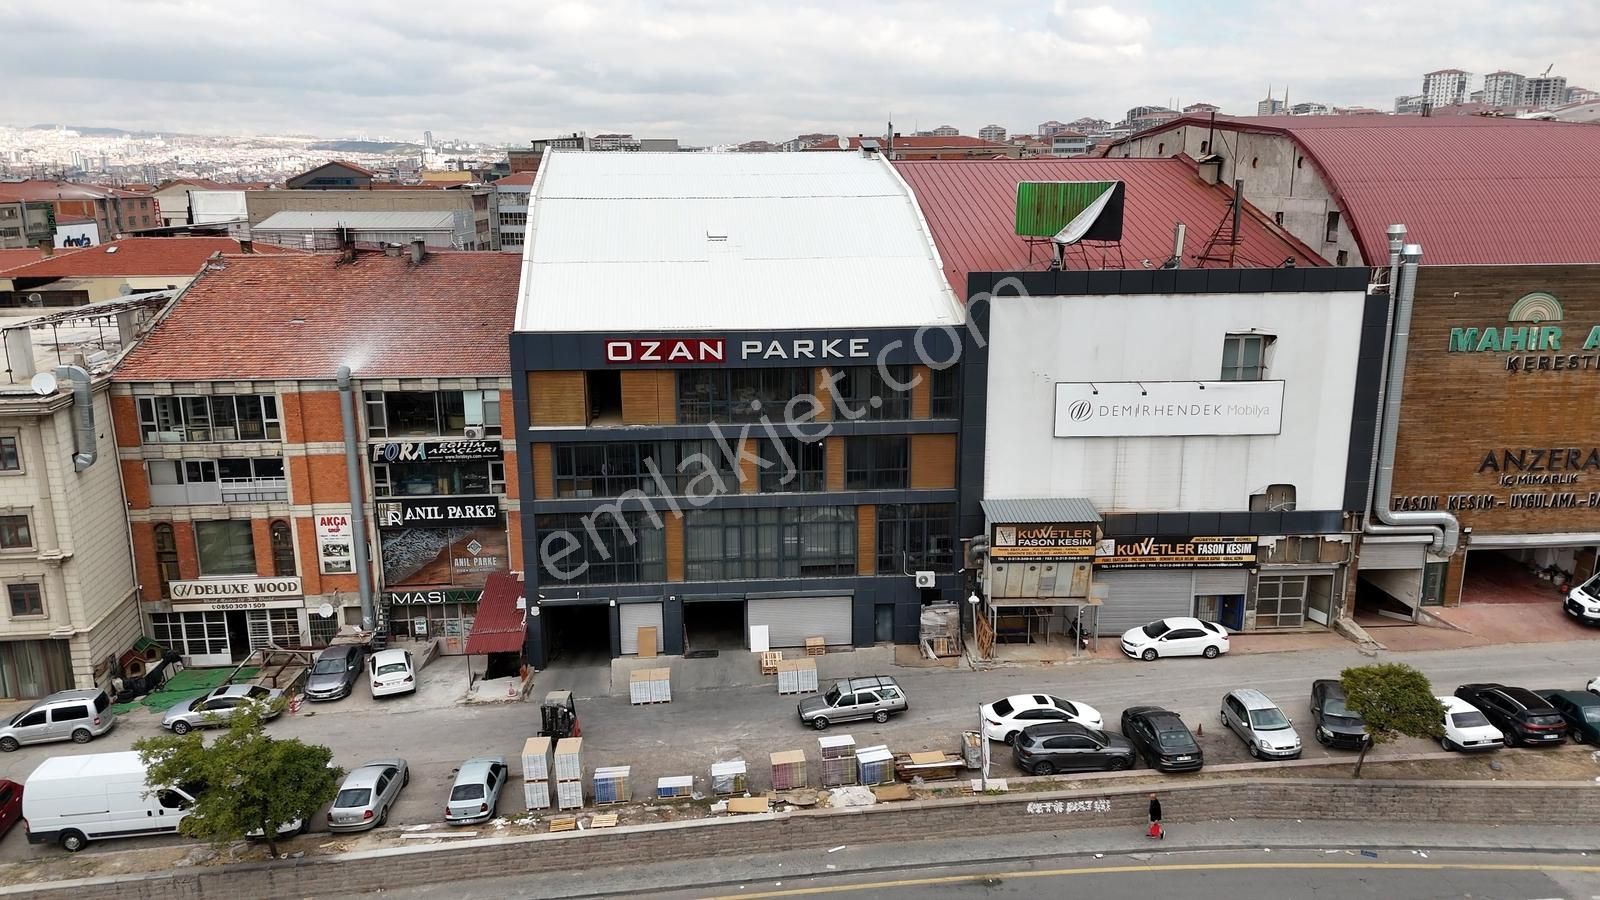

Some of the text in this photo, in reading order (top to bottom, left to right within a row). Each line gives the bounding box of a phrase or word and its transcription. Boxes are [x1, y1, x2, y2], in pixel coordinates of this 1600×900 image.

[607, 338, 870, 361] OZAN PARKE
[1227, 403, 1270, 419] Mobilya
[373, 442, 427, 461] FORA
[1478, 448, 1600, 473] ANZERA
[1393, 496, 1439, 511] FASON
[404, 504, 497, 520] ANIL PARKE
[320, 516, 347, 529] AKÇA
[1018, 538, 1055, 546] FASON
[1197, 543, 1225, 555] FASON
[473, 556, 497, 566] PARKE
[194, 581, 298, 596] DELUXE WOOD
